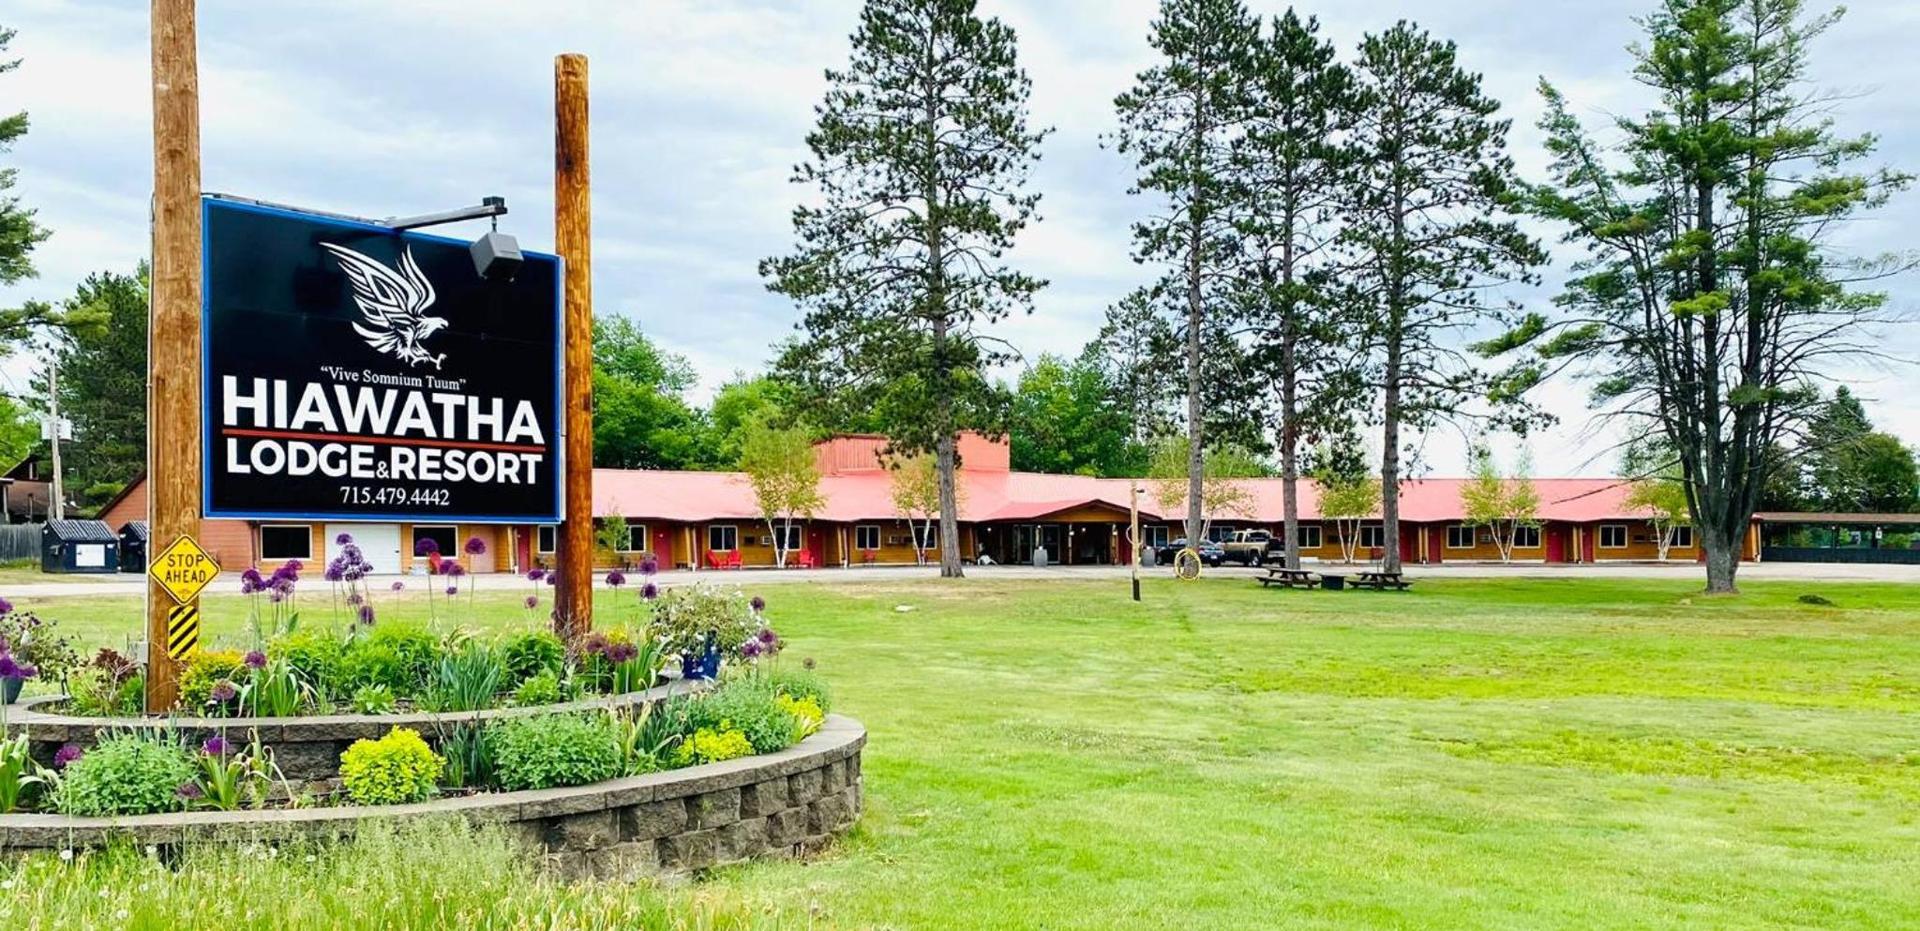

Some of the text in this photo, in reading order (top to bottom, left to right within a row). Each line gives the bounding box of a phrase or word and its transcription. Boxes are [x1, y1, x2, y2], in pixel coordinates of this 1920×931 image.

[363, 369, 422, 387] Somnium
[223, 375, 545, 444] HIAWATHA
[340, 486, 450, 505] 715.479.4442
[167, 553, 205, 568] STOP
[165, 570, 206, 583] AHEAD
